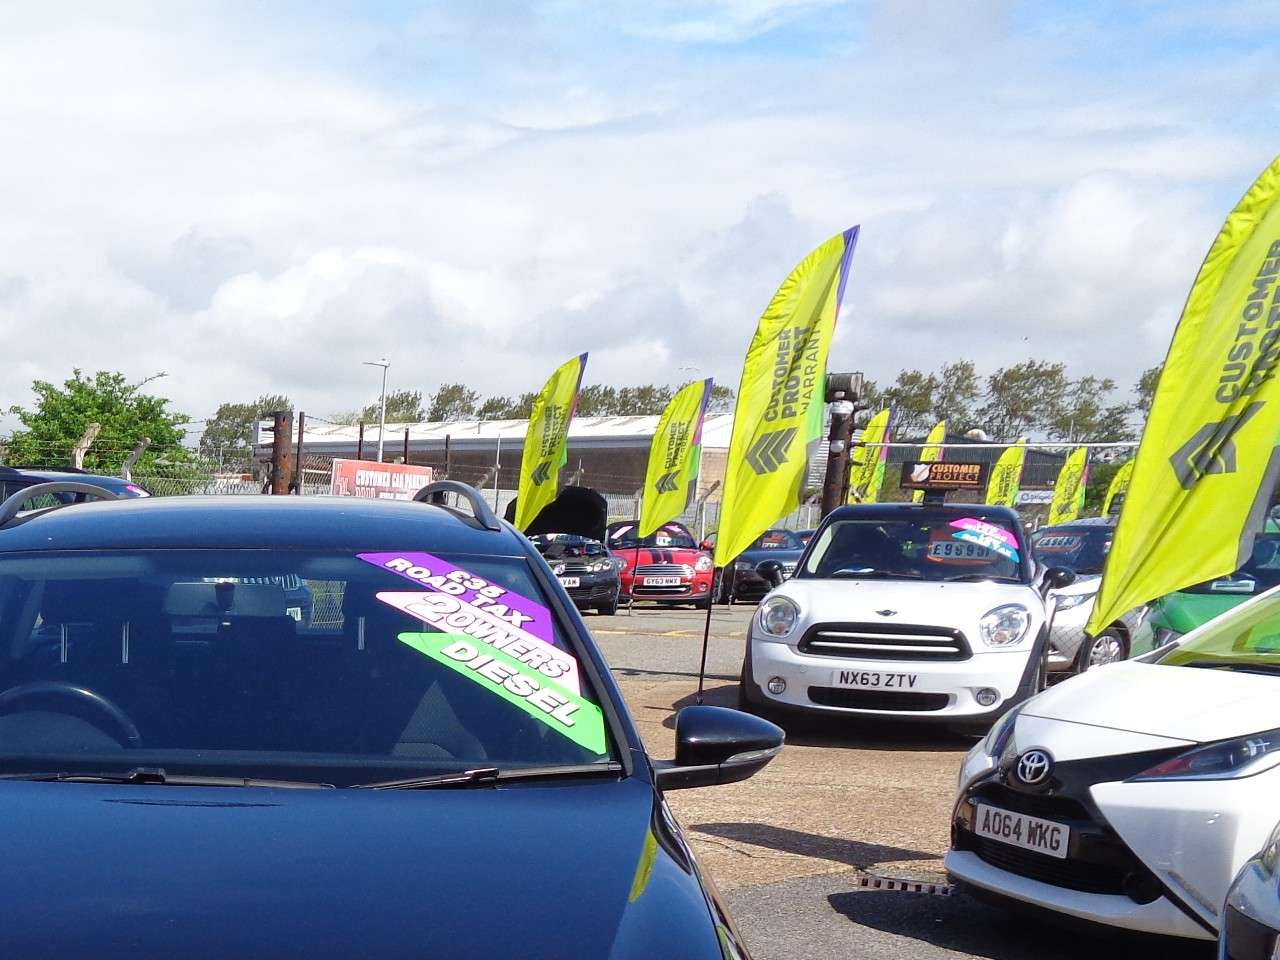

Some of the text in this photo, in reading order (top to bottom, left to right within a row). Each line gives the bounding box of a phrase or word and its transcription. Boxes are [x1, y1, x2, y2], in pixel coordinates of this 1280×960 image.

[765, 328, 791, 422] CUSTOMER
[781, 326, 811, 419] PROTECT
[930, 472, 979, 481] PROTECT
[932, 464, 980, 474] CUSTOMER
[384, 557, 535, 626] ROAD TAX
[446, 612, 571, 679] OWNERS
[839, 670, 917, 688] NX63 ZTV
[439, 639, 581, 727] DIESEL
[982, 808, 1061, 851] AO64 WKG
